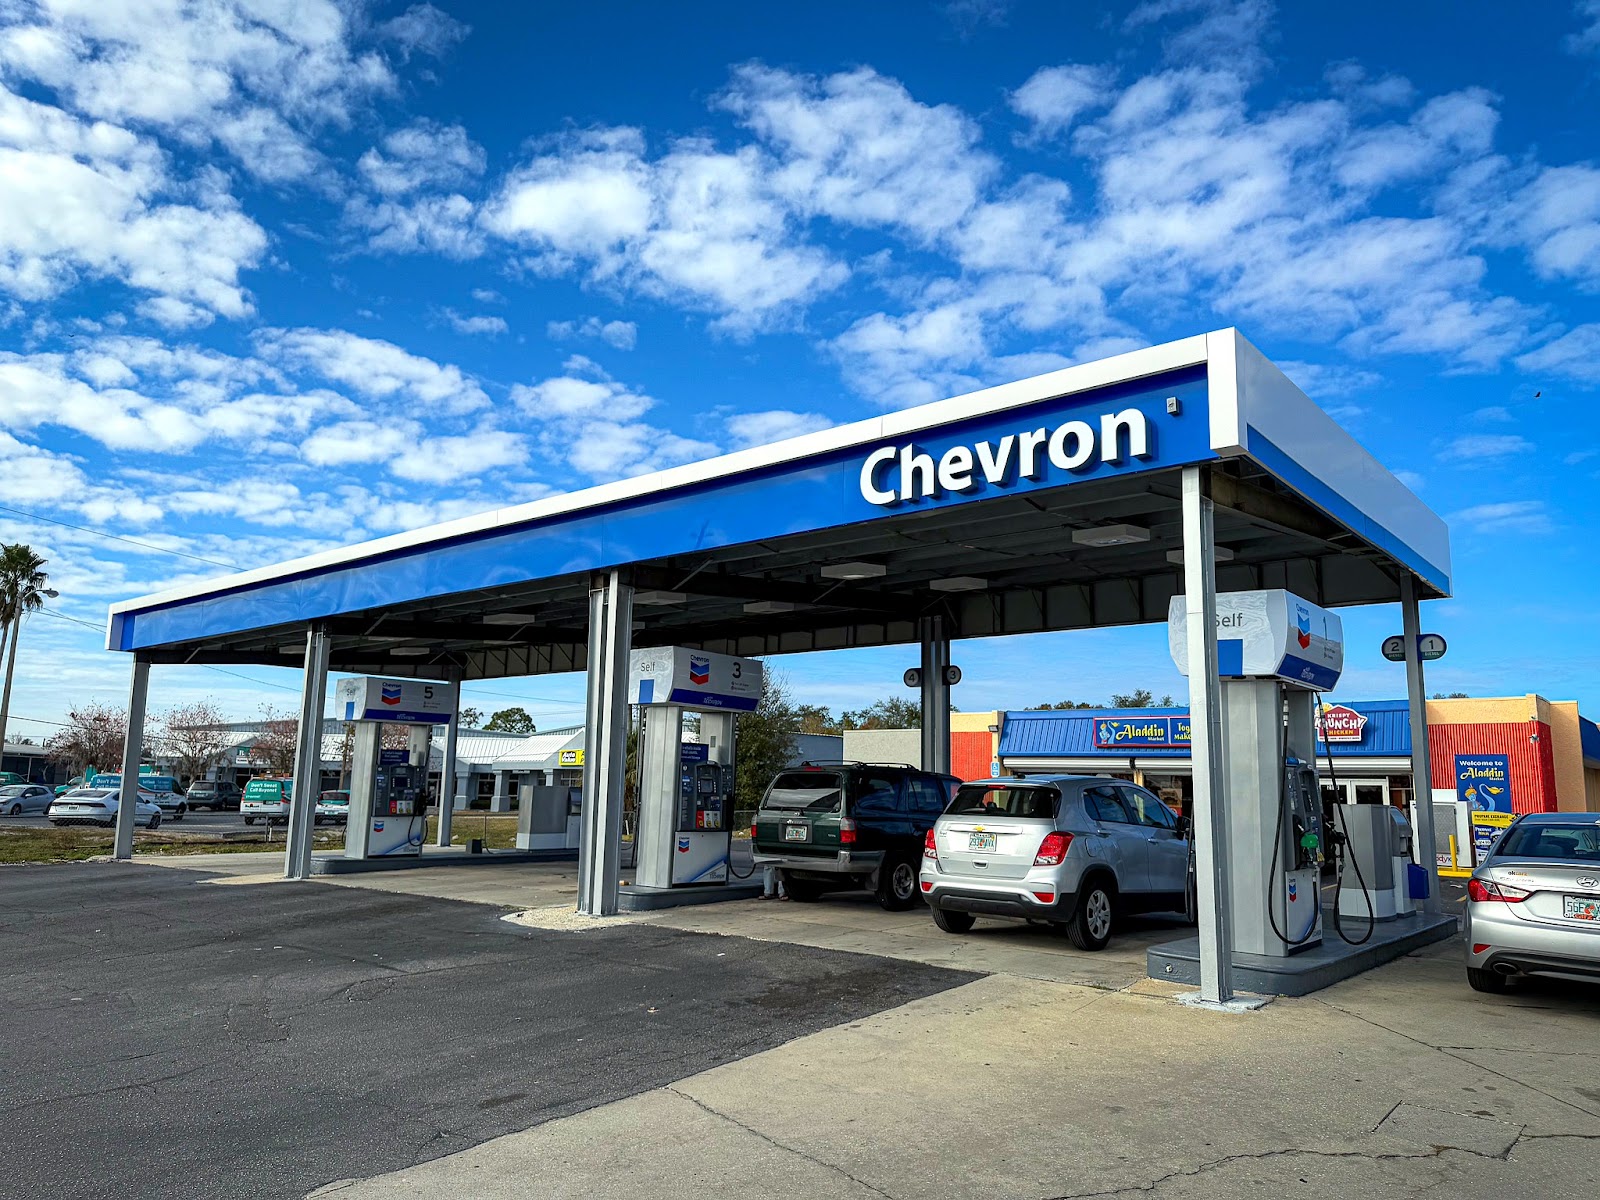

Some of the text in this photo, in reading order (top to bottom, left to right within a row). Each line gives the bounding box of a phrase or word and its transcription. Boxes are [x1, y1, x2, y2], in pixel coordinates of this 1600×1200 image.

[860, 407, 1148, 505] Chevron
[1391, 641, 1400, 652] 2
[1428, 639, 1434, 650] 1
[640, 662, 655, 672] Self
[732, 661, 741, 679] 3
[908, 673, 915, 682] 4
[949, 670, 957, 680] 3
[424, 686, 434, 699] 5
[1116, 724, 1164, 740] Aladdin
[1460, 767, 1504, 780] Aladdin
